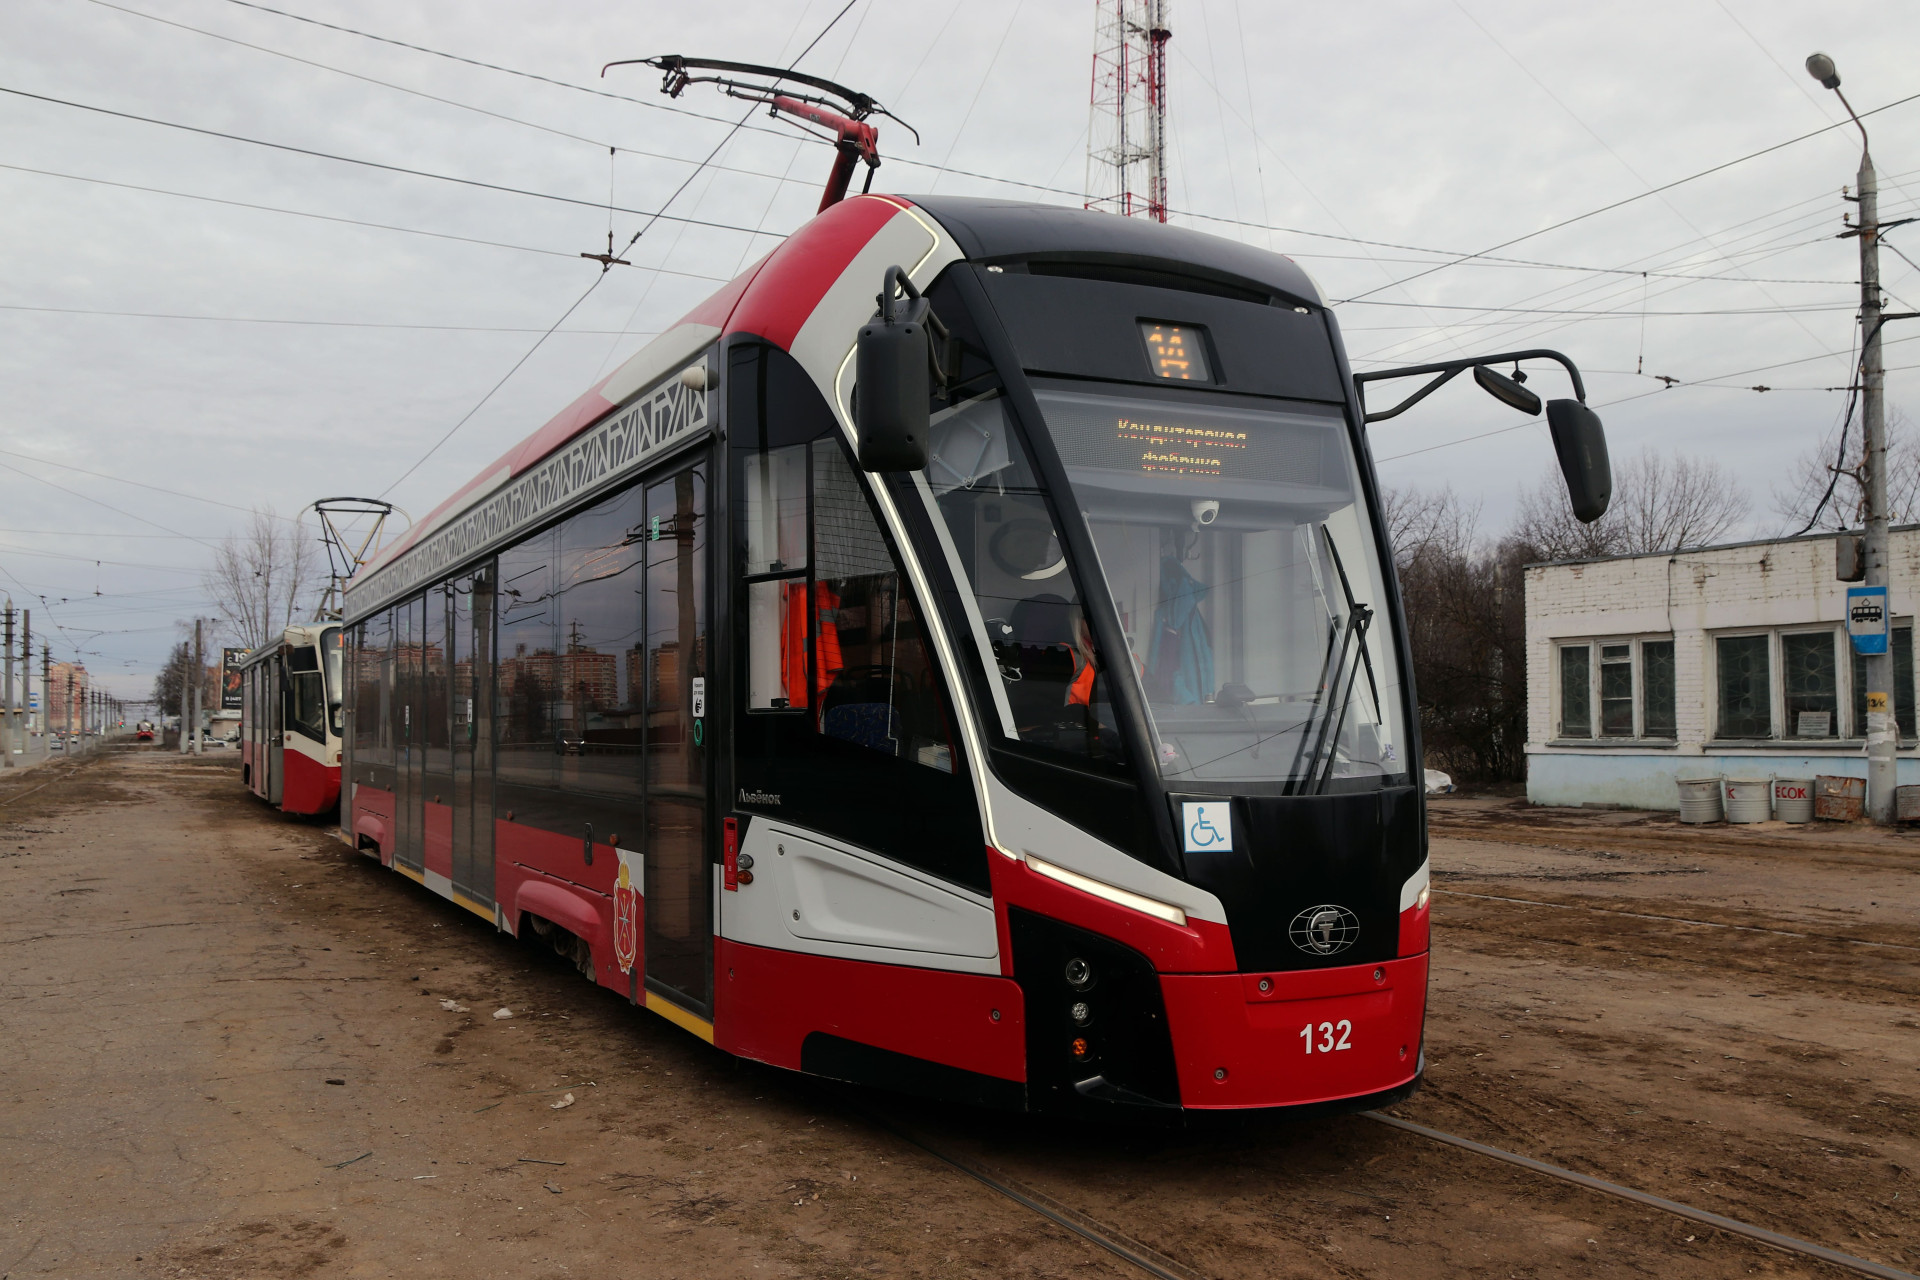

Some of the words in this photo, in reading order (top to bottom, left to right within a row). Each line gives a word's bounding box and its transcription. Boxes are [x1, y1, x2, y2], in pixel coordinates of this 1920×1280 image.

[739, 788, 781, 805] Львёнок
[1776, 786, 1807, 799] ЕСОК
[1300, 1019, 1352, 1055] 132
